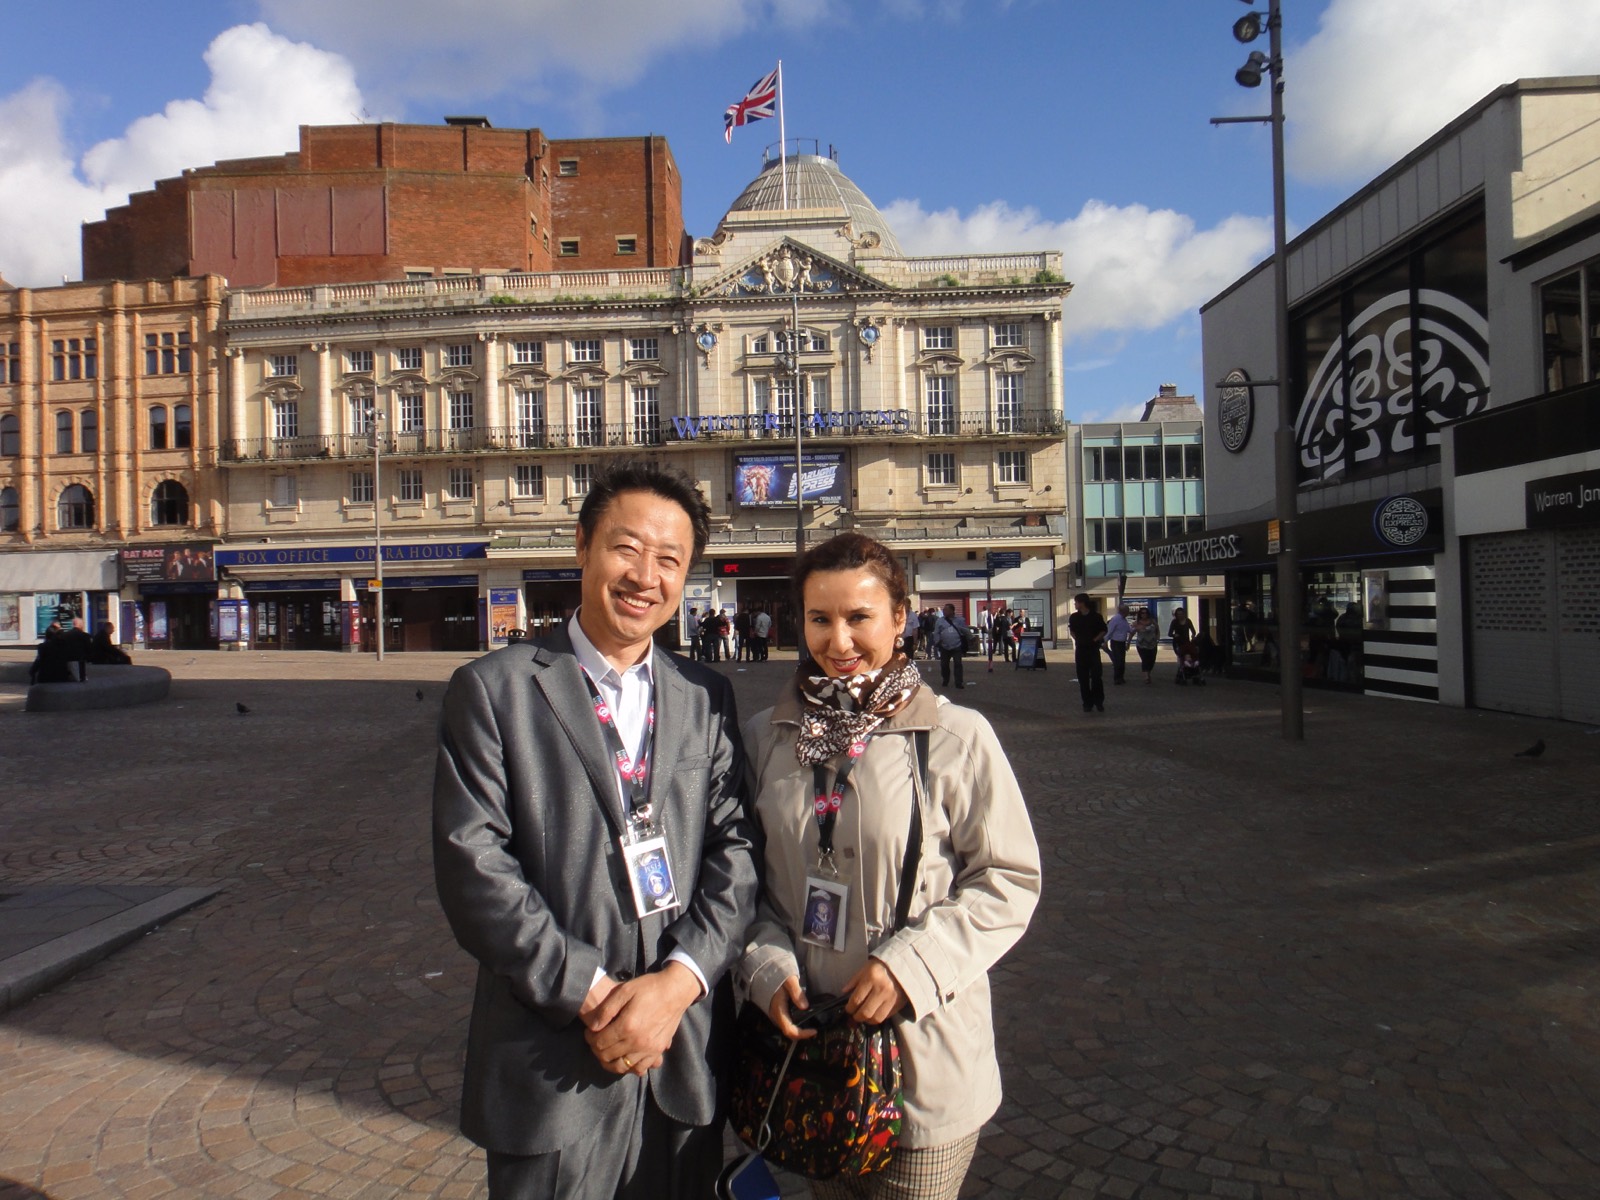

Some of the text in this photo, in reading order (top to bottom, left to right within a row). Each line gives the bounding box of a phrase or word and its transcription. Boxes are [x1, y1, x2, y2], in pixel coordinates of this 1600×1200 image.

[671, 409, 910, 439] WINTER GARDENS
[1534, 491, 1573, 512] Warren
[1385, 519, 1423, 527] EXPRESS
[123, 549, 165, 559] RAT PACK
[238, 551, 267, 563] BOX
[277, 549, 329, 562] OFFICE
[410, 545, 463, 558] HOUSE
[1148, 534, 1239, 567] PIZZAEXPRESS
